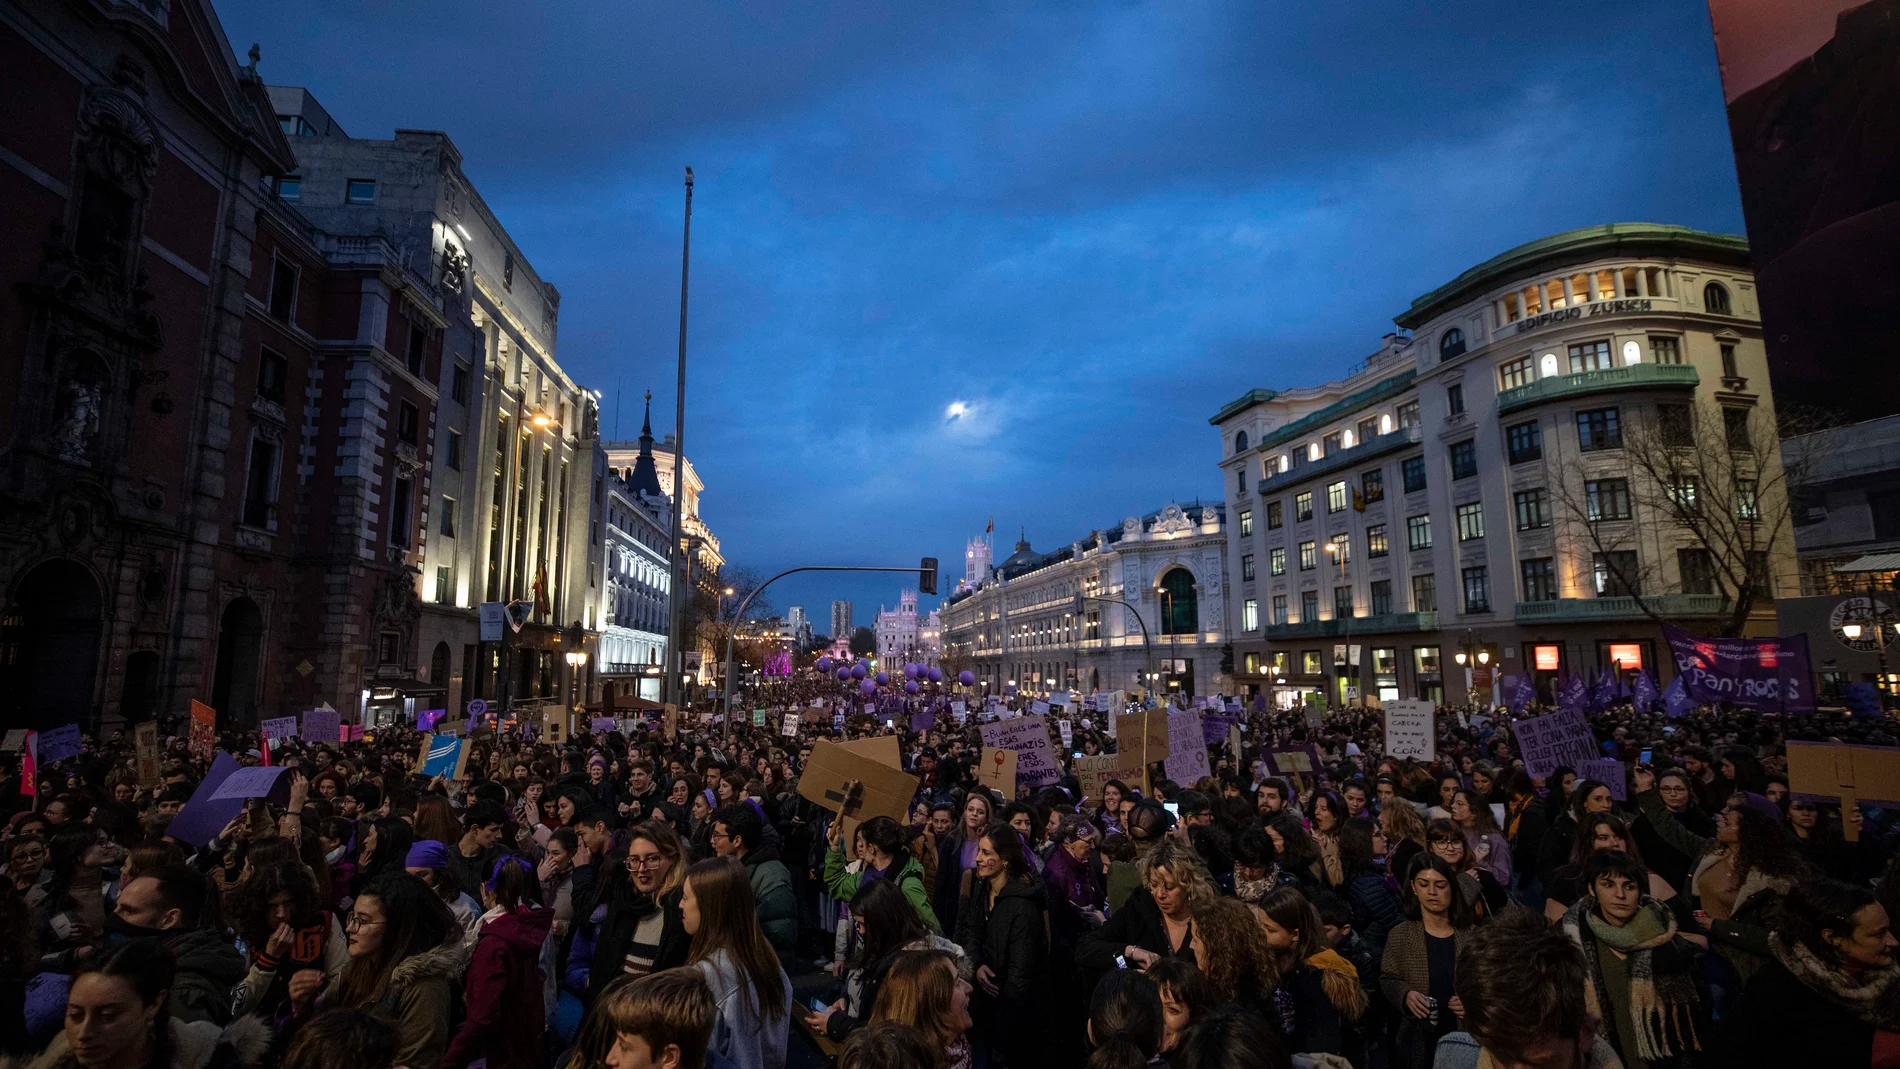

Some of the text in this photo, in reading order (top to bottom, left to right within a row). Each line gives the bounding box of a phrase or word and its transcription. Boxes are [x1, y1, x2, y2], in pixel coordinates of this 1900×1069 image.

[1518, 307, 1581, 332] EDIFICIO
[1850, 642, 1879, 652] BELLA
[1010, 725, 1027, 734] ERES
[1518, 711, 1579, 735] NON FAI FALTA
[999, 735, 1018, 746] ESAS
[1523, 723, 1589, 749] TER CONA PARA
[1018, 752, 1038, 761] ERES
[1392, 746, 1425, 755] COÑO
[1526, 736, 1599, 767] COLLER FREGONA
[1024, 759, 1045, 768] ESOS
[1078, 758, 1093, 771] LO
[1530, 760, 1556, 774] UNHA
[1016, 768, 1060, 783] NORANTES
[1097, 767, 1144, 782] FEMINISMO
[1084, 782, 1095, 791] ES
